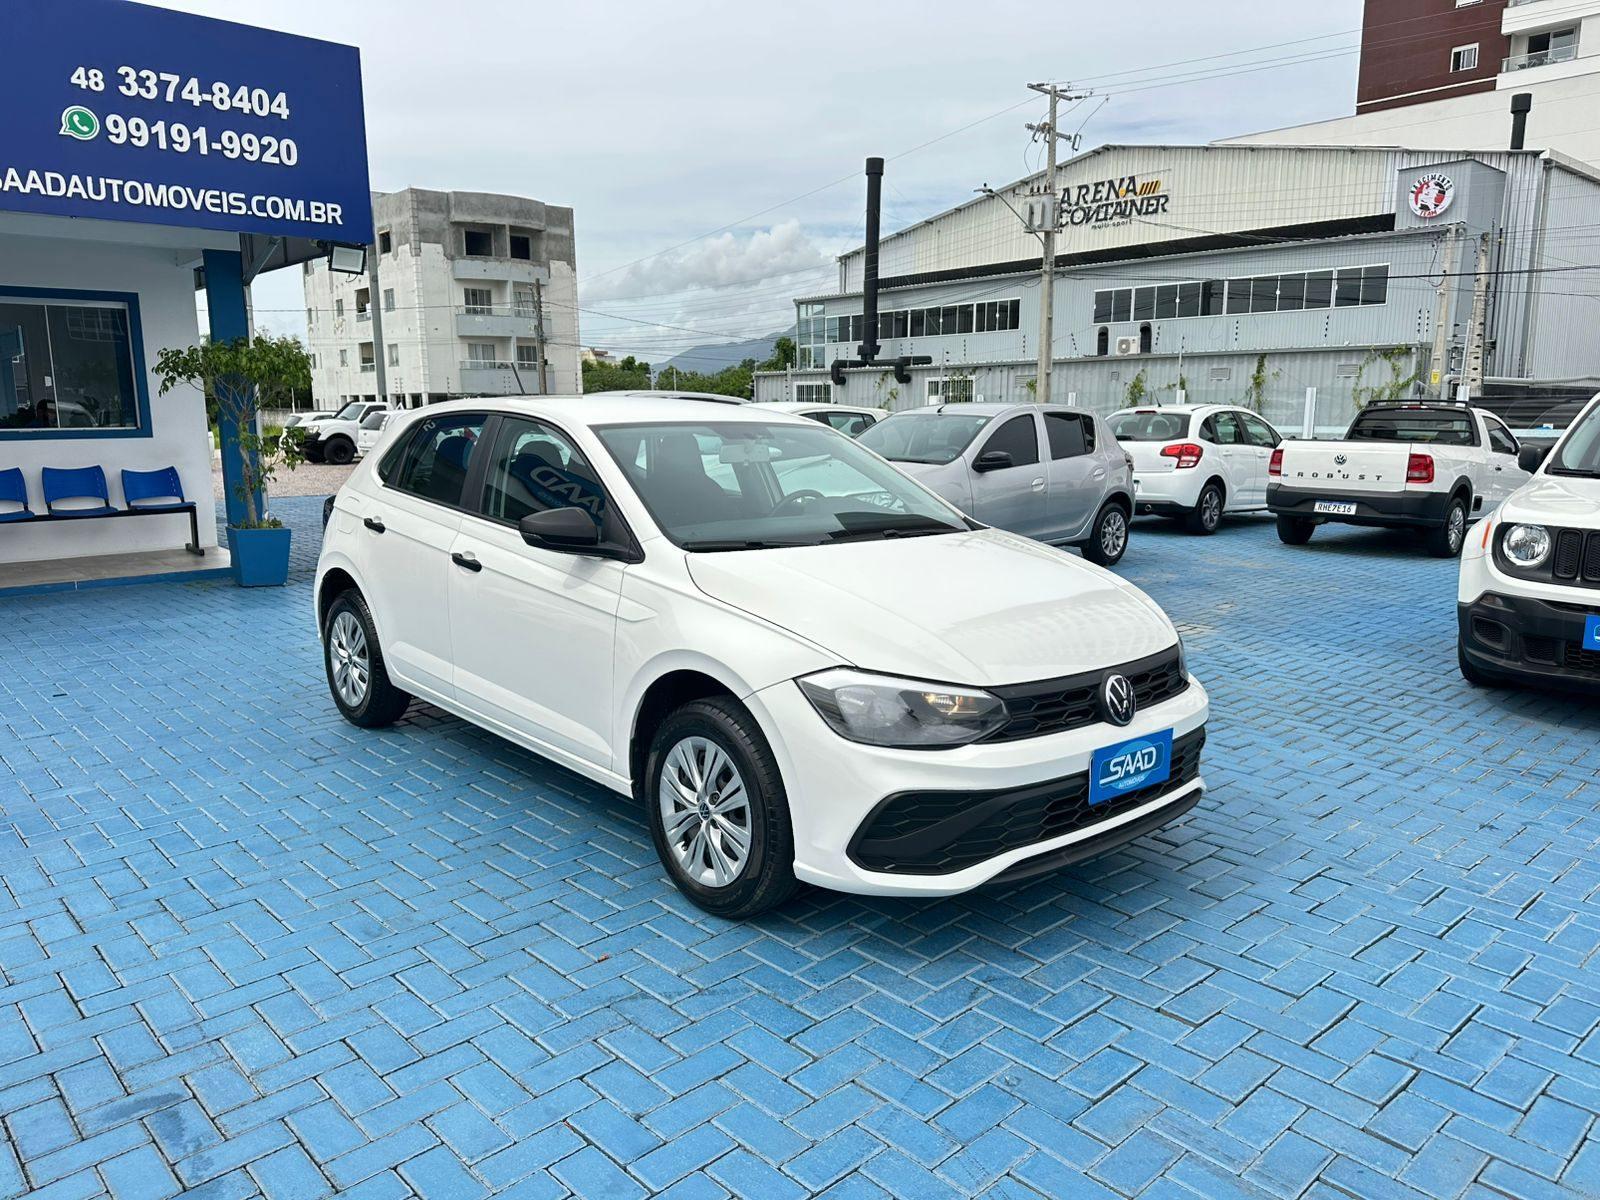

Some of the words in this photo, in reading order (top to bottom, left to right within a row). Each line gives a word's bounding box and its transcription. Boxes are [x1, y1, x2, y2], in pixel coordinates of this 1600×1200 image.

[70, 66, 105, 92] 48
[117, 66, 290, 120] 3374-8404
[105, 114, 298, 166] 99191-9920
[0, 167, 343, 225] AADAUTOMOVEIS.COM.BR
[1060, 175, 1138, 207] ARENA
[1059, 194, 1169, 228] CONTAINER
[1297, 472, 1382, 481] ROBUST
[1317, 503, 1352, 513] RHE7E16
[1099, 746, 1157, 785] SAAD
